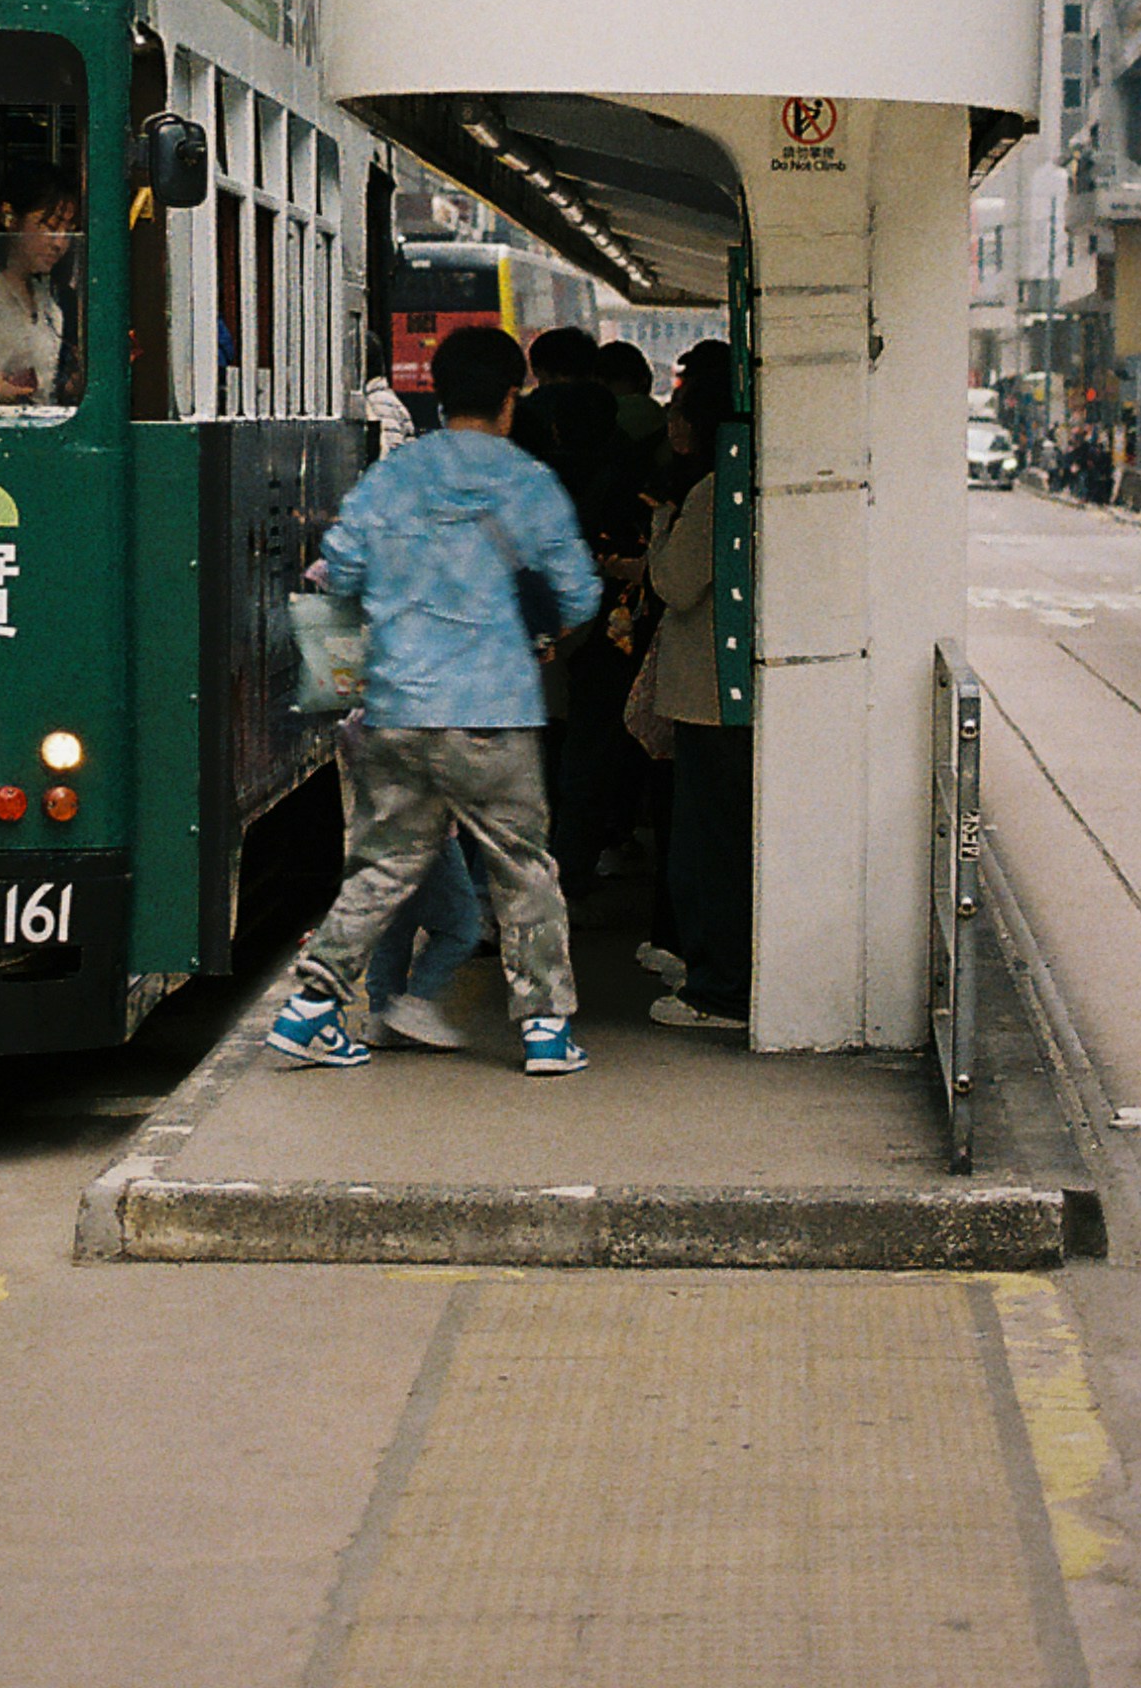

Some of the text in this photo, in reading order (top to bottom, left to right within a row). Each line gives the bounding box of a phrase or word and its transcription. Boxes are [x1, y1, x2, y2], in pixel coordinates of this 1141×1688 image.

[771, 159, 846, 172] Do Not Climb
[5, 883, 74, 944] 161
